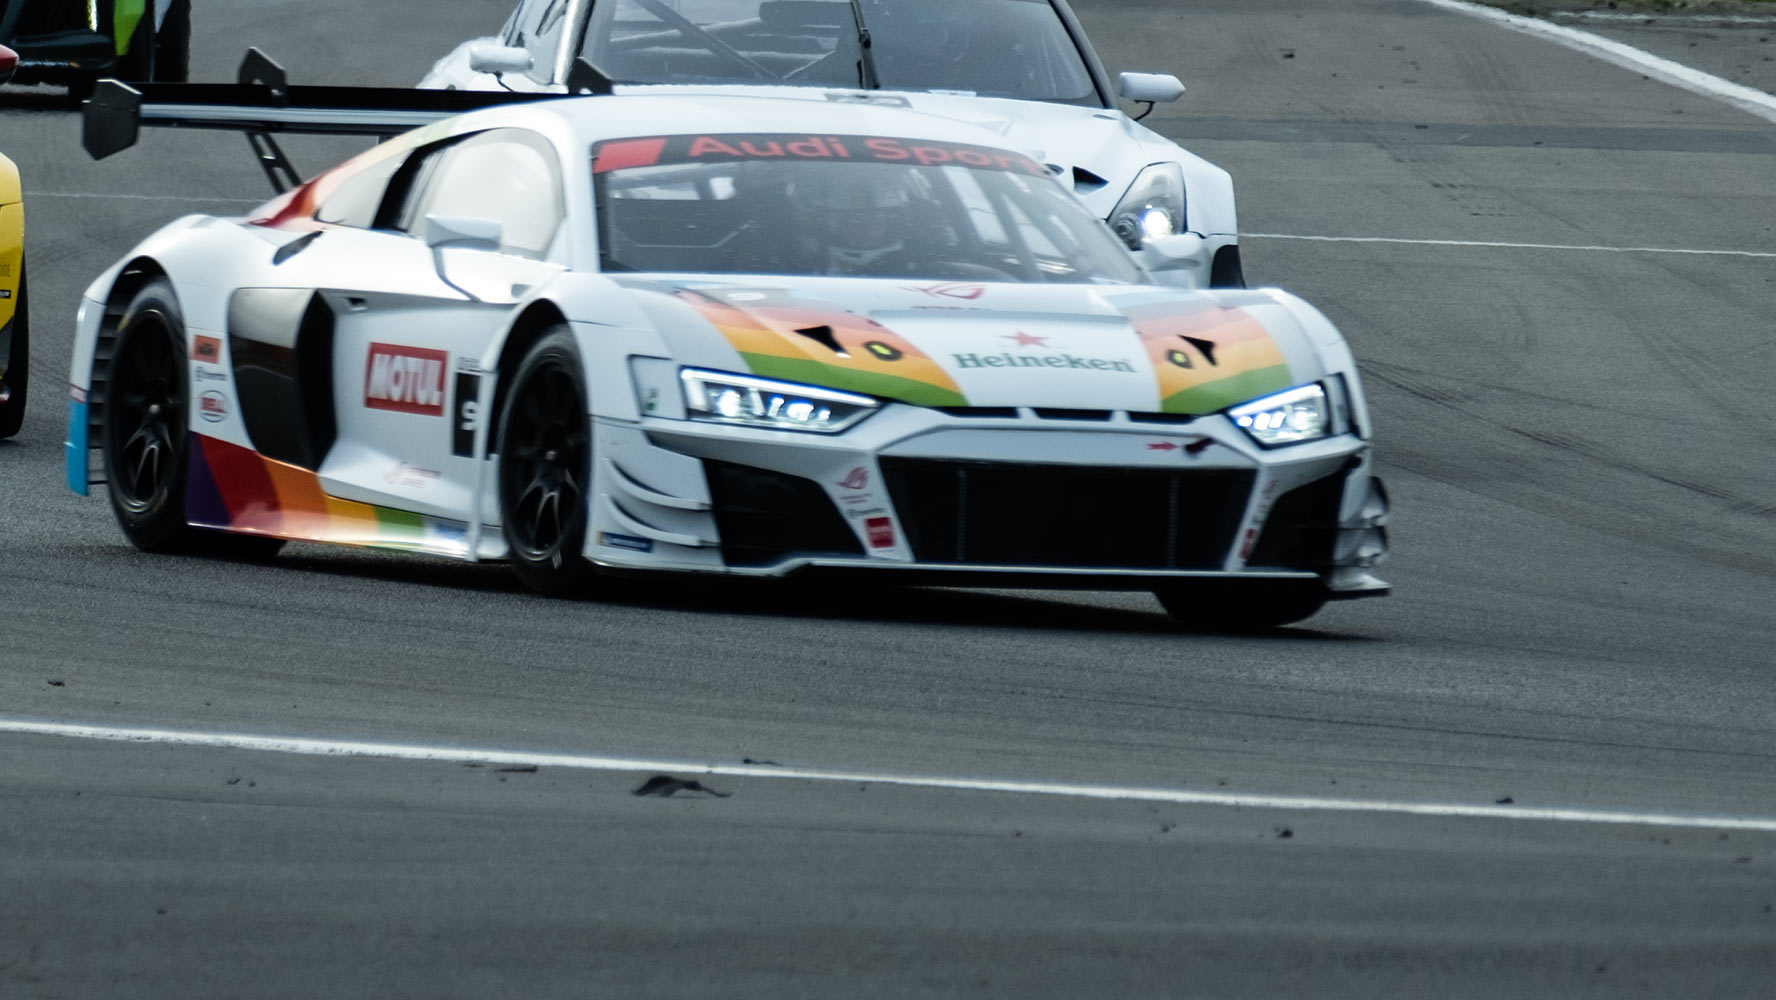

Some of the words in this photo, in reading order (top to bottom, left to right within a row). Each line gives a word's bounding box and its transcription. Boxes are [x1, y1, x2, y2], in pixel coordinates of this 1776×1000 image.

[688, 135, 851, 158] Audi
[951, 352, 1137, 373] Heineken
[368, 353, 443, 406] MOTUL
